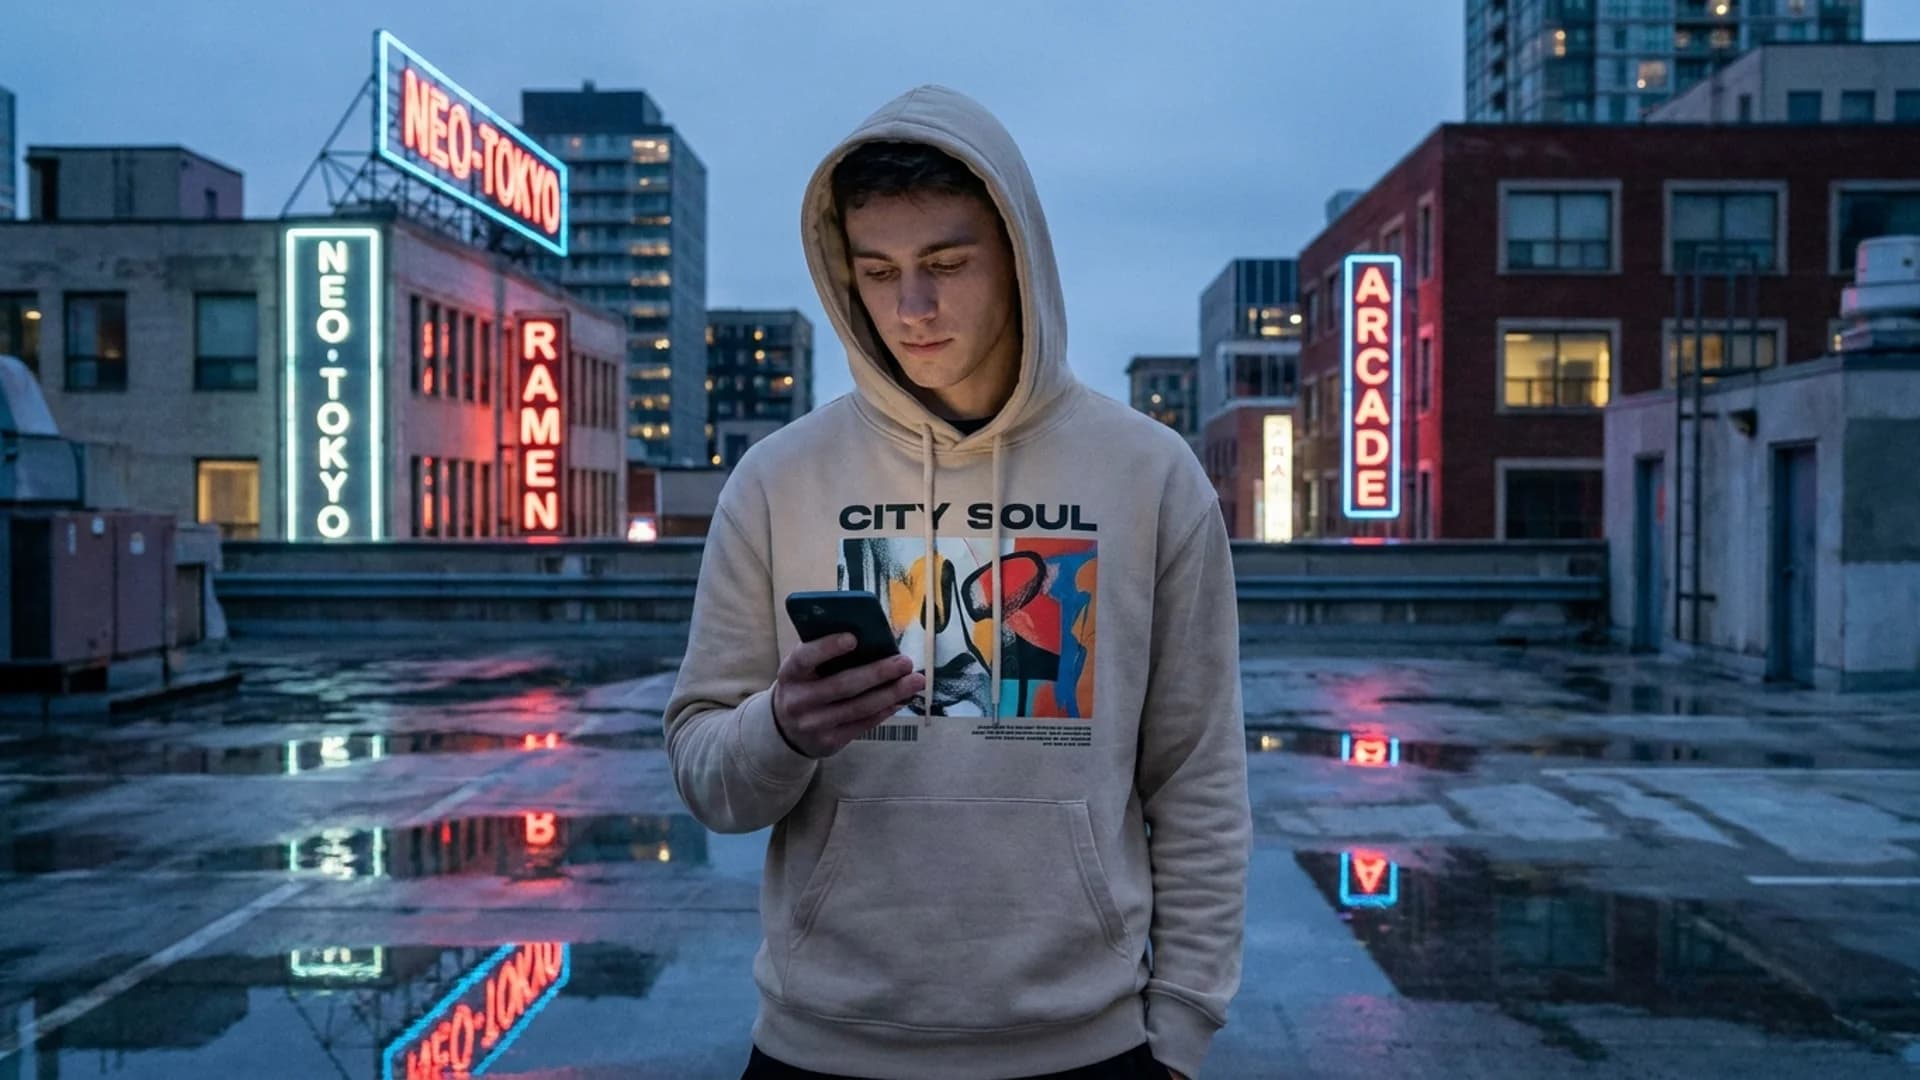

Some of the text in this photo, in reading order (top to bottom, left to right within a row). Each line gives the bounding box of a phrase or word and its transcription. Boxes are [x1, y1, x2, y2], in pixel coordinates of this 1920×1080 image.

[402, 67, 561, 235] NEO-TOKYO
[520, 320, 561, 530] RAMEN
[1354, 266, 1391, 507] ARCADE
[839, 502, 1098, 532] CITY SOUL
